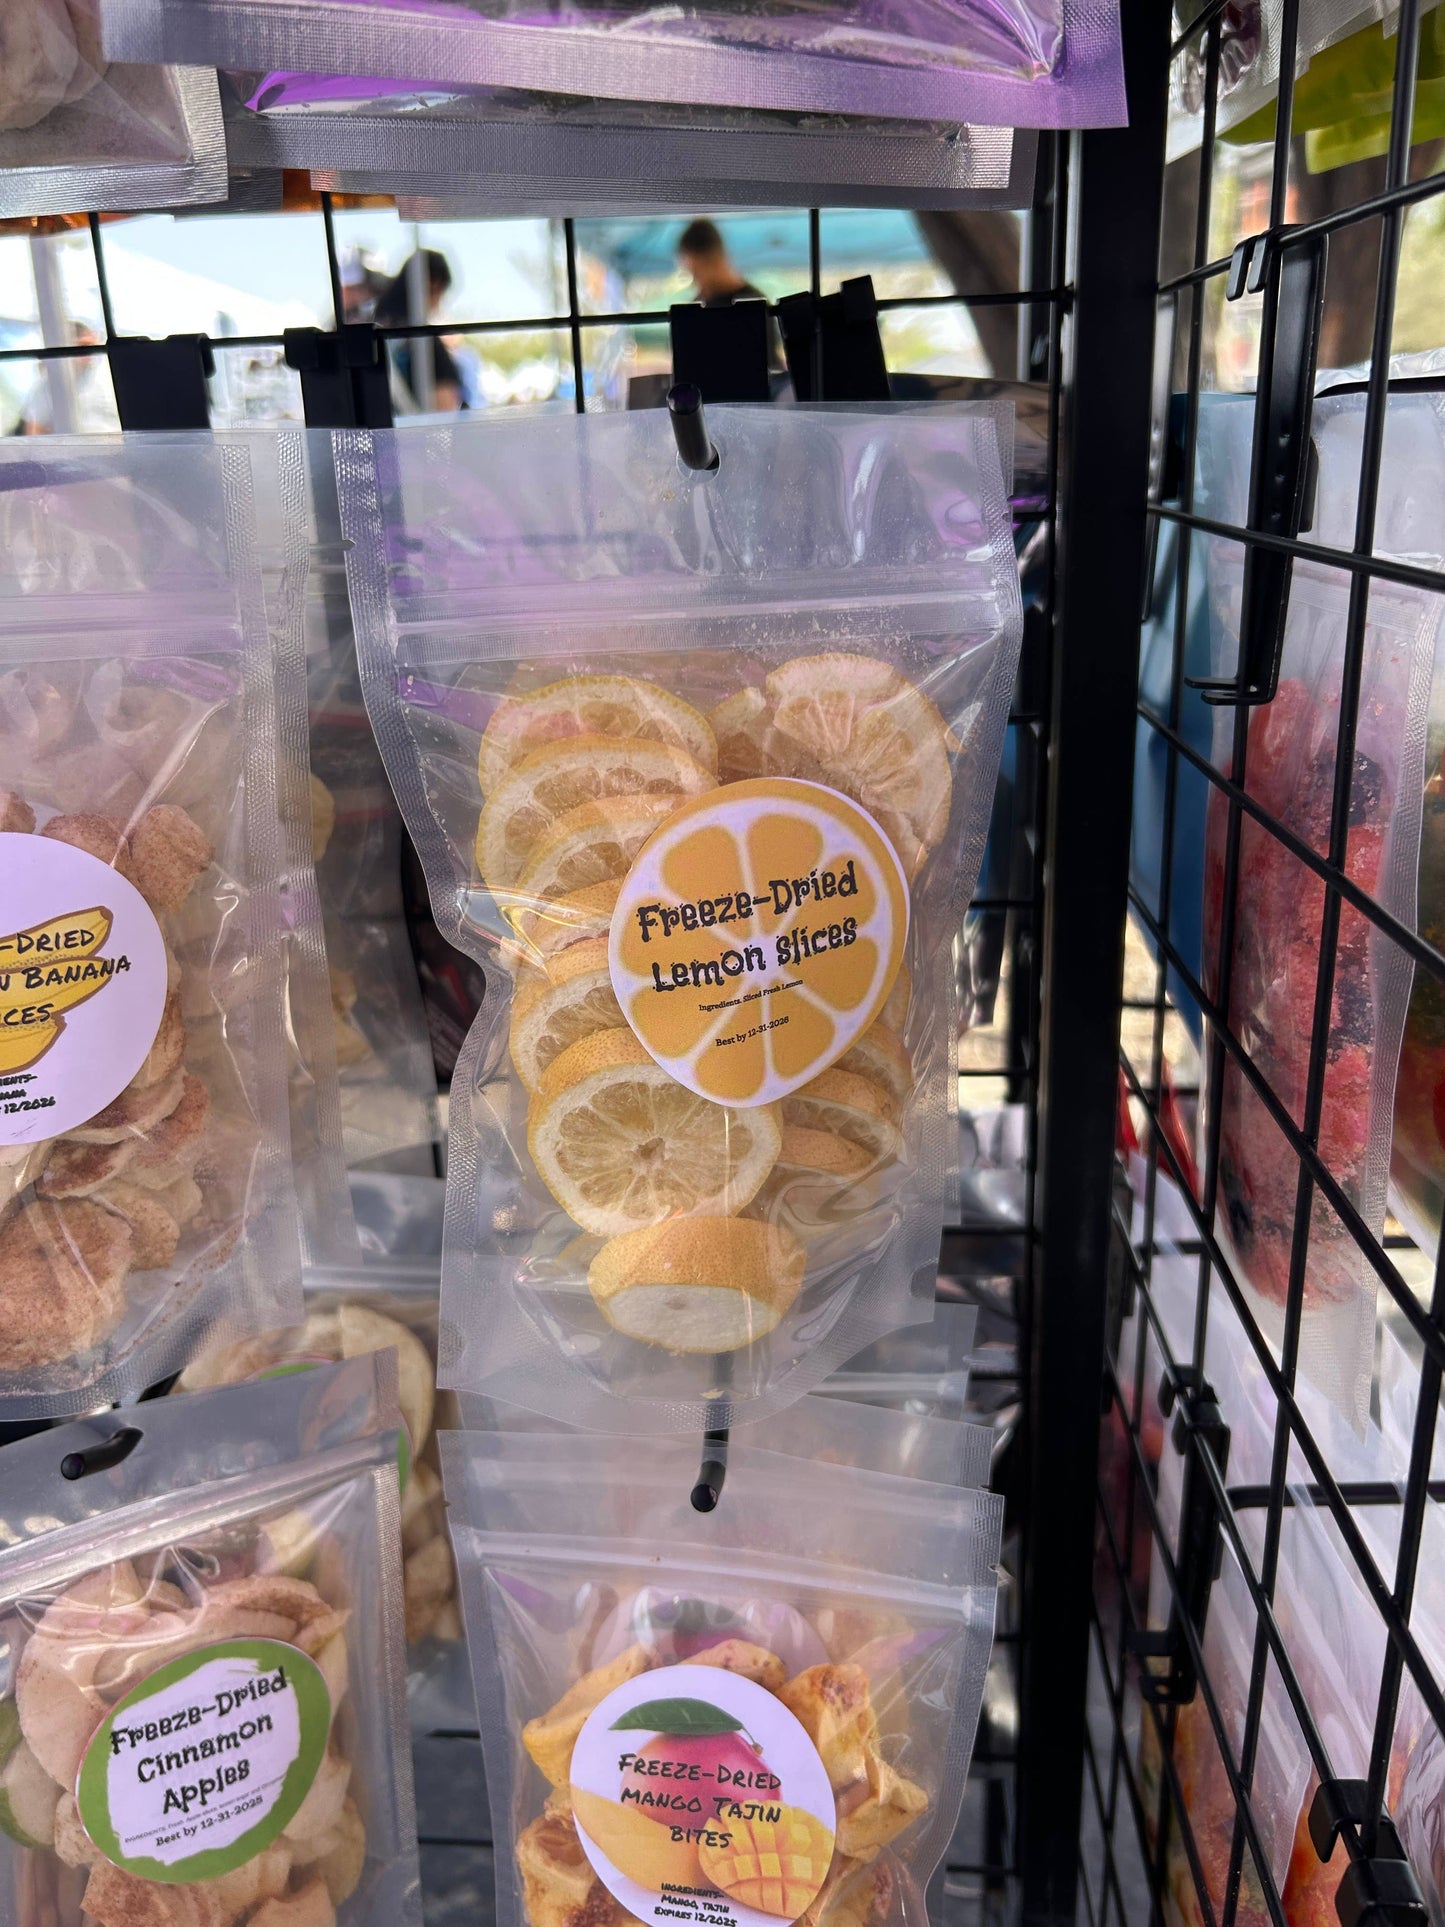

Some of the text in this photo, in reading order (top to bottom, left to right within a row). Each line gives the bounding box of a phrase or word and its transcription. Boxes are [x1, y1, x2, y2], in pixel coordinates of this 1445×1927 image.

[637, 860, 858, 942] Freeze-Dried
[21, 955, 131, 989] BANANA
[652, 945, 766, 992] Lemon
[763, 985, 780, 996] Fresh
[715, 1036, 735, 1046] Best
[736, 1033, 747, 1043] by
[110, 1666, 288, 1755] Freeze-Dried
[137, 1713, 273, 1783] Cinnamon
[163, 1759, 250, 1814] Apples
[618, 1753, 781, 1790] FREEZE-DRIED
[621, 1787, 781, 1823] MANGO TAJIN
[156, 1830, 182, 1847] Best
[183, 1824, 198, 1838] by
[669, 1825, 733, 1848] BITES
[654, 1906, 692, 1920] EXPIRES
